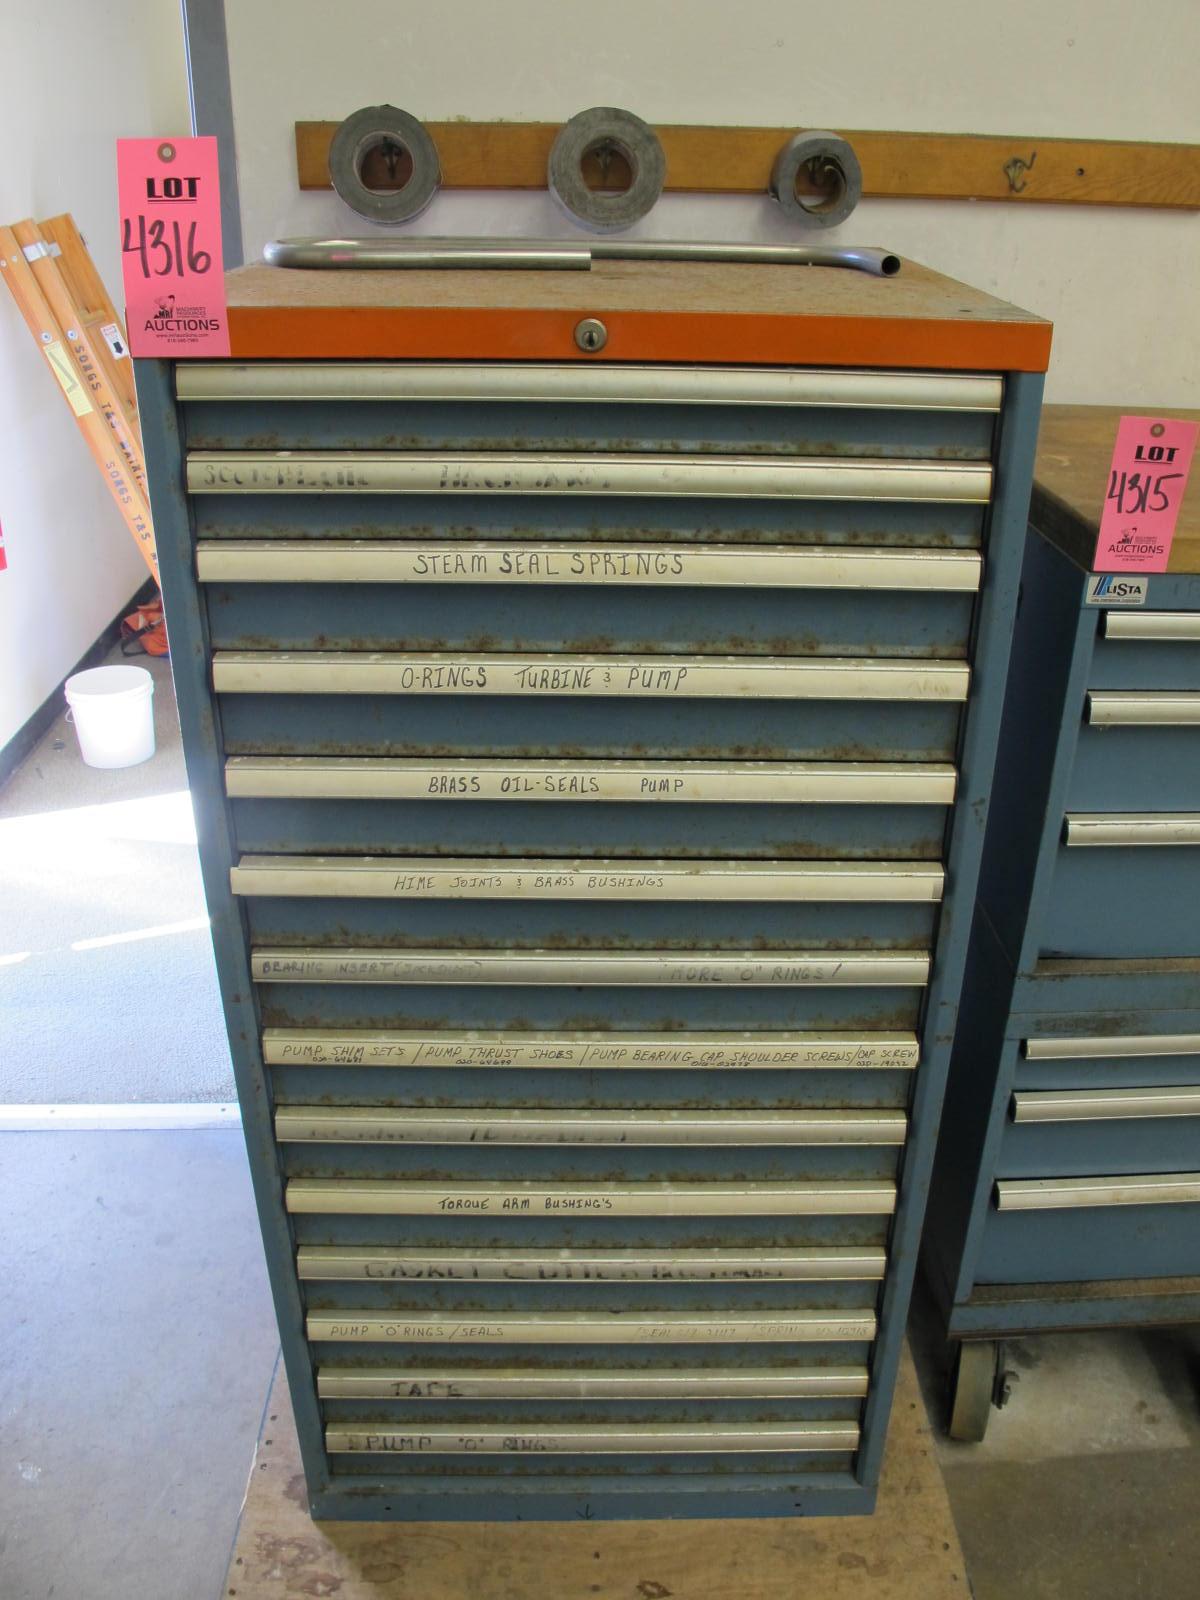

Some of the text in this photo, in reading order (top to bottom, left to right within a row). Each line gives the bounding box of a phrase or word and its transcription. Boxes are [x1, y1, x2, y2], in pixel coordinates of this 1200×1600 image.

[146, 177, 201, 199] LOT
[122, 215, 211, 278] 4316
[144, 319, 220, 331] AUCTIONS
[1134, 445, 1179, 462] LOT
[1107, 470, 1184, 514] 4315
[1108, 544, 1164, 554] AUCTIONS
[412, 553, 683, 575] STEAM SEAL SPRINGS
[401, 667, 487, 689] O-RINGS
[514, 665, 595, 689] TURBINE
[627, 667, 688, 691] PUMP
[428, 775, 684, 793] BRASS OIL-SEALS PUMP
[394, 876, 436, 890] HIME
[449, 876, 502, 888] JOINTS
[534, 876, 575, 888] BRASS
[588, 875, 664, 888] BUSHINGS
[282, 1045, 323, 1057] PUMP
[331, 1046, 364, 1056] SHIM
[370, 1046, 408, 1057] SETS
[425, 1046, 462, 1058] PUMP
[469, 1047, 524, 1059] THRUST
[529, 1049, 574, 1059] SHOES
[589, 1048, 628, 1061] PUMP
[632, 1050, 694, 1062] BEARING
[700, 1051, 725, 1062] CAP
[729, 1051, 799, 1062] SHOULDER
[881, 1049, 917, 1059] SCREW
[439, 1197, 613, 1209] TORQUE ARM BUSHING'S
[330, 1326, 369, 1336] PUMP
[404, 1327, 445, 1337] RINGS
[461, 1327, 504, 1337] SEALS
[367, 1437, 432, 1450] PUMP
